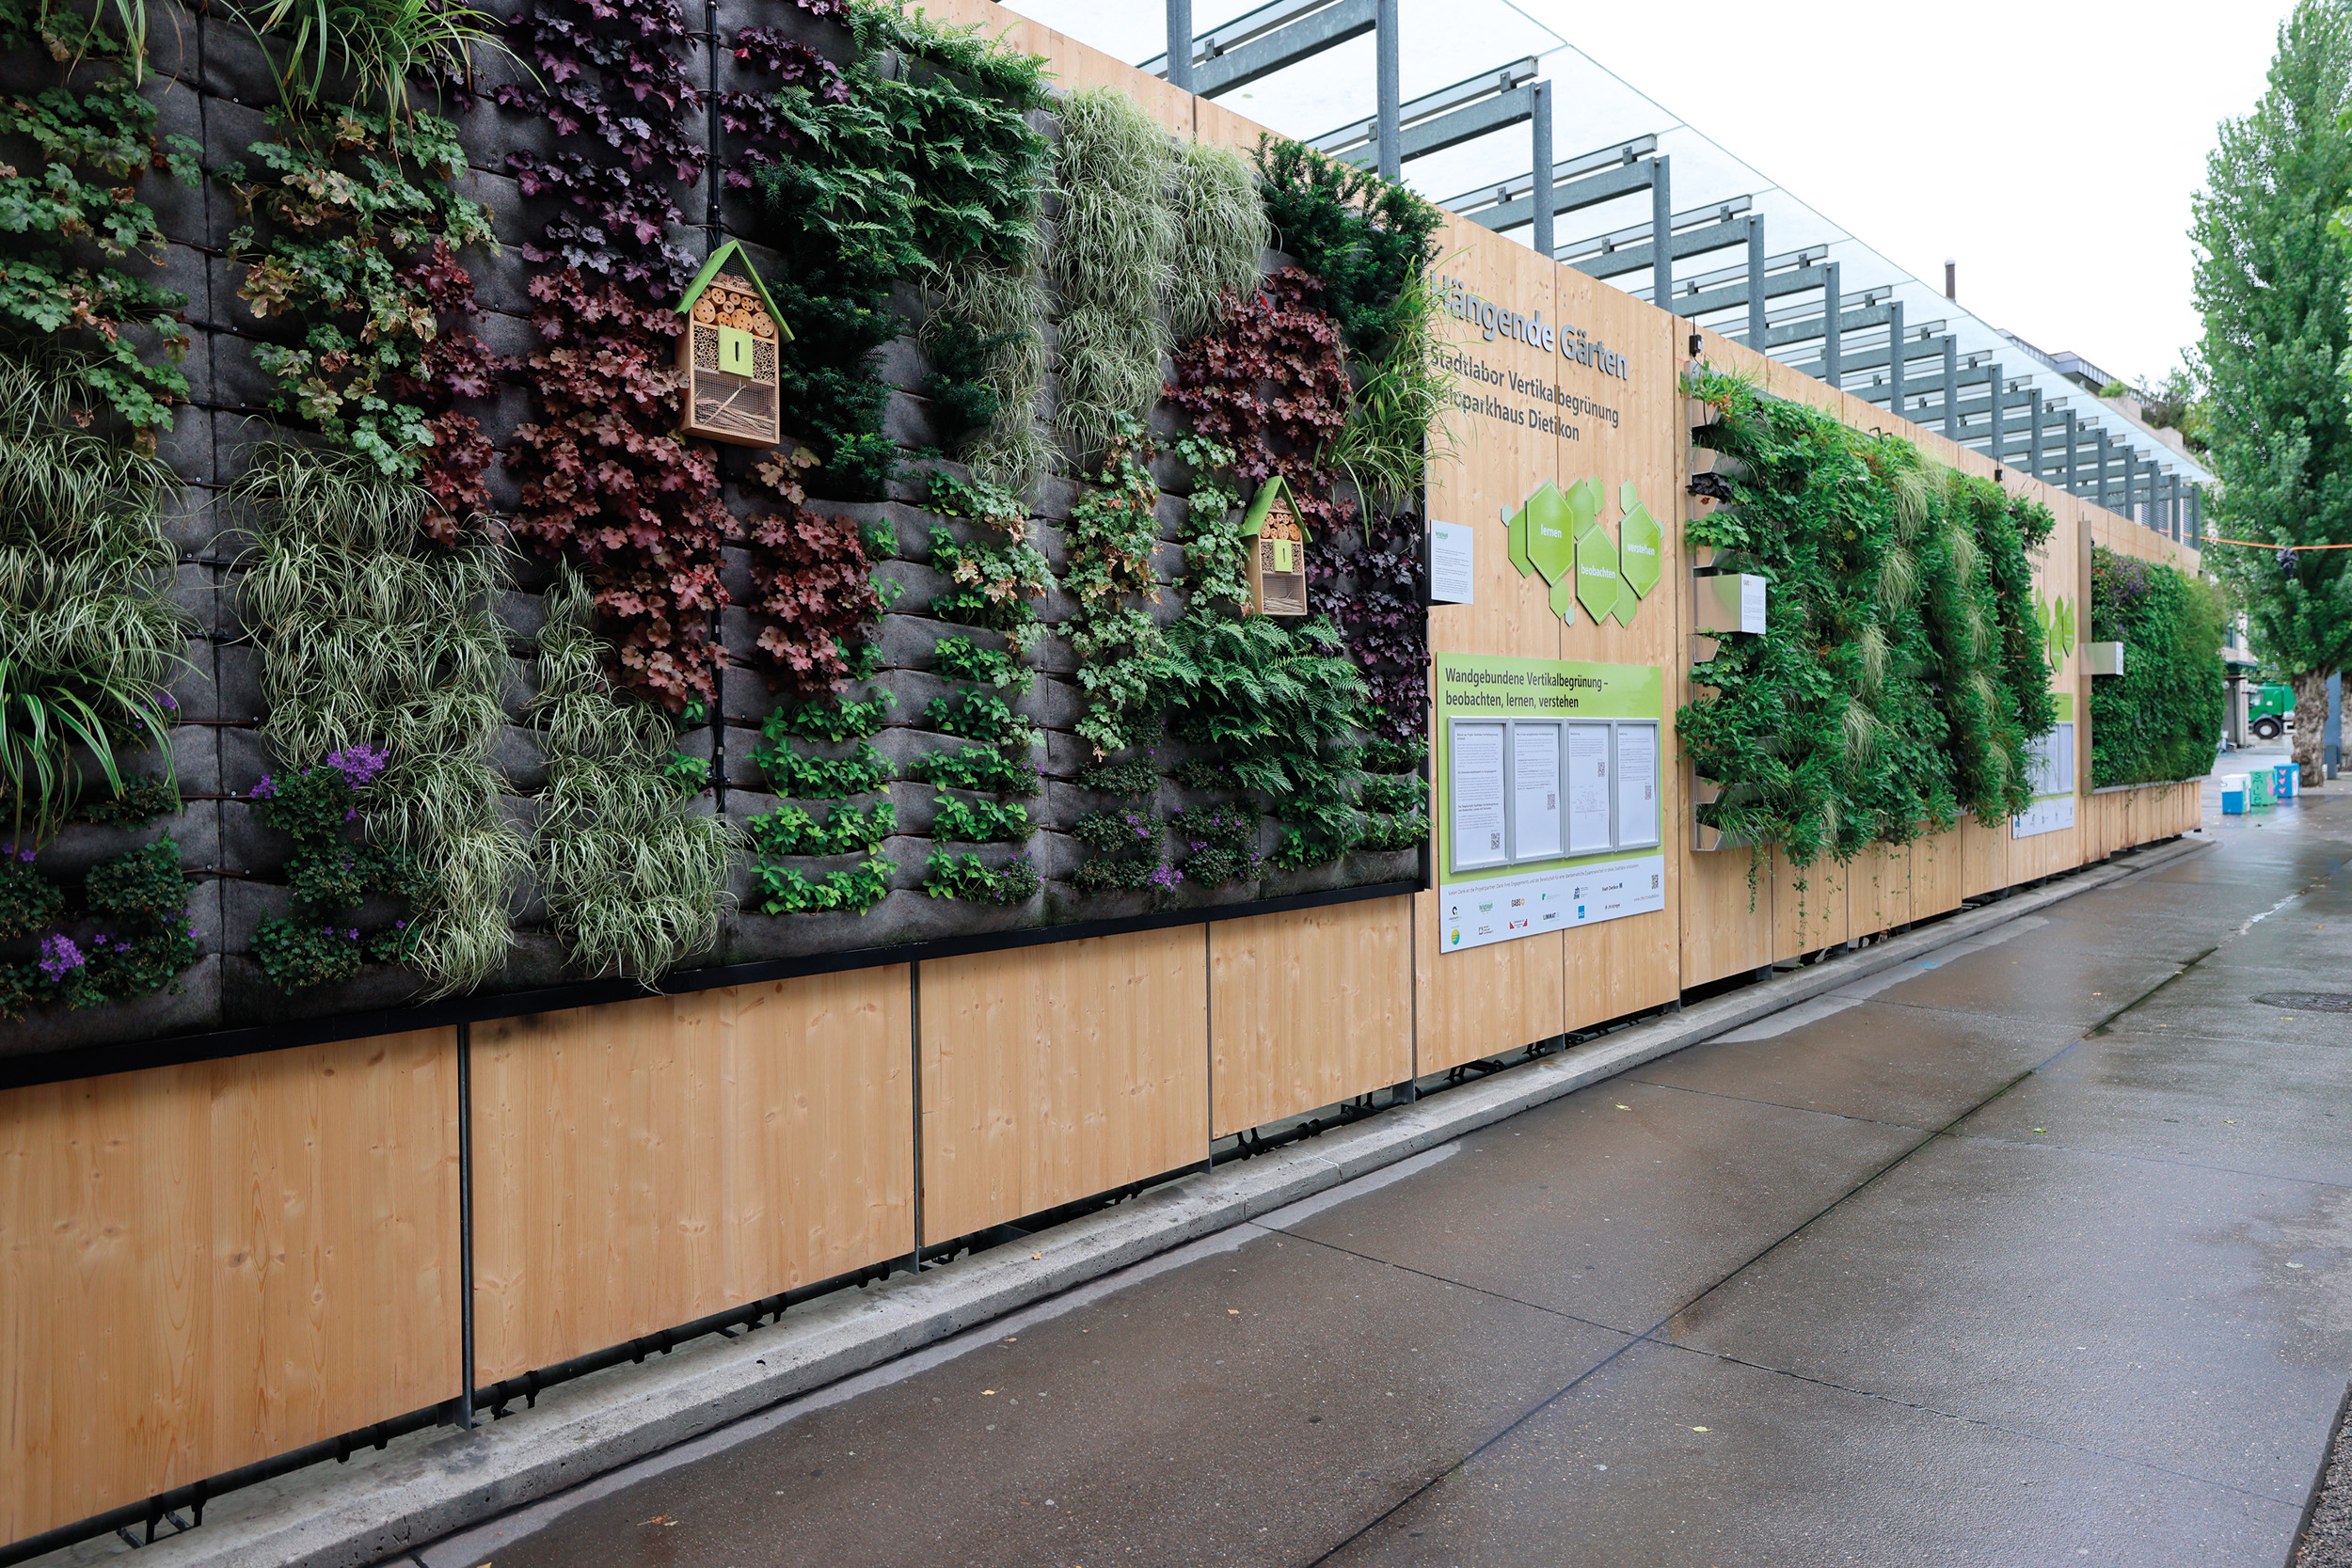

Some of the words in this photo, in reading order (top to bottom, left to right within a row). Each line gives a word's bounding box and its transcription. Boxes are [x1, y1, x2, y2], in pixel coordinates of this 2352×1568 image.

[1429, 269, 1554, 353] Hängende
[1561, 324, 1629, 380] Gärten
[1430, 345, 1504, 388] Stadtlabor
[1508, 370, 1619, 428] Vertikalbegrünung
[1529, 408, 1580, 441] Dietikon
[1540, 523, 1562, 539] lernen
[1627, 543, 1656, 557] verstehen
[1581, 562, 1616, 579] beobachten
[1445, 667, 1525, 687] Wandgebundene
[1526, 672, 1602, 692] Vertikalbegrünung
[1445, 689, 1503, 708] beobachten,
[1506, 692, 1536, 709] lernen,
[1538, 694, 1579, 708] verstehen
